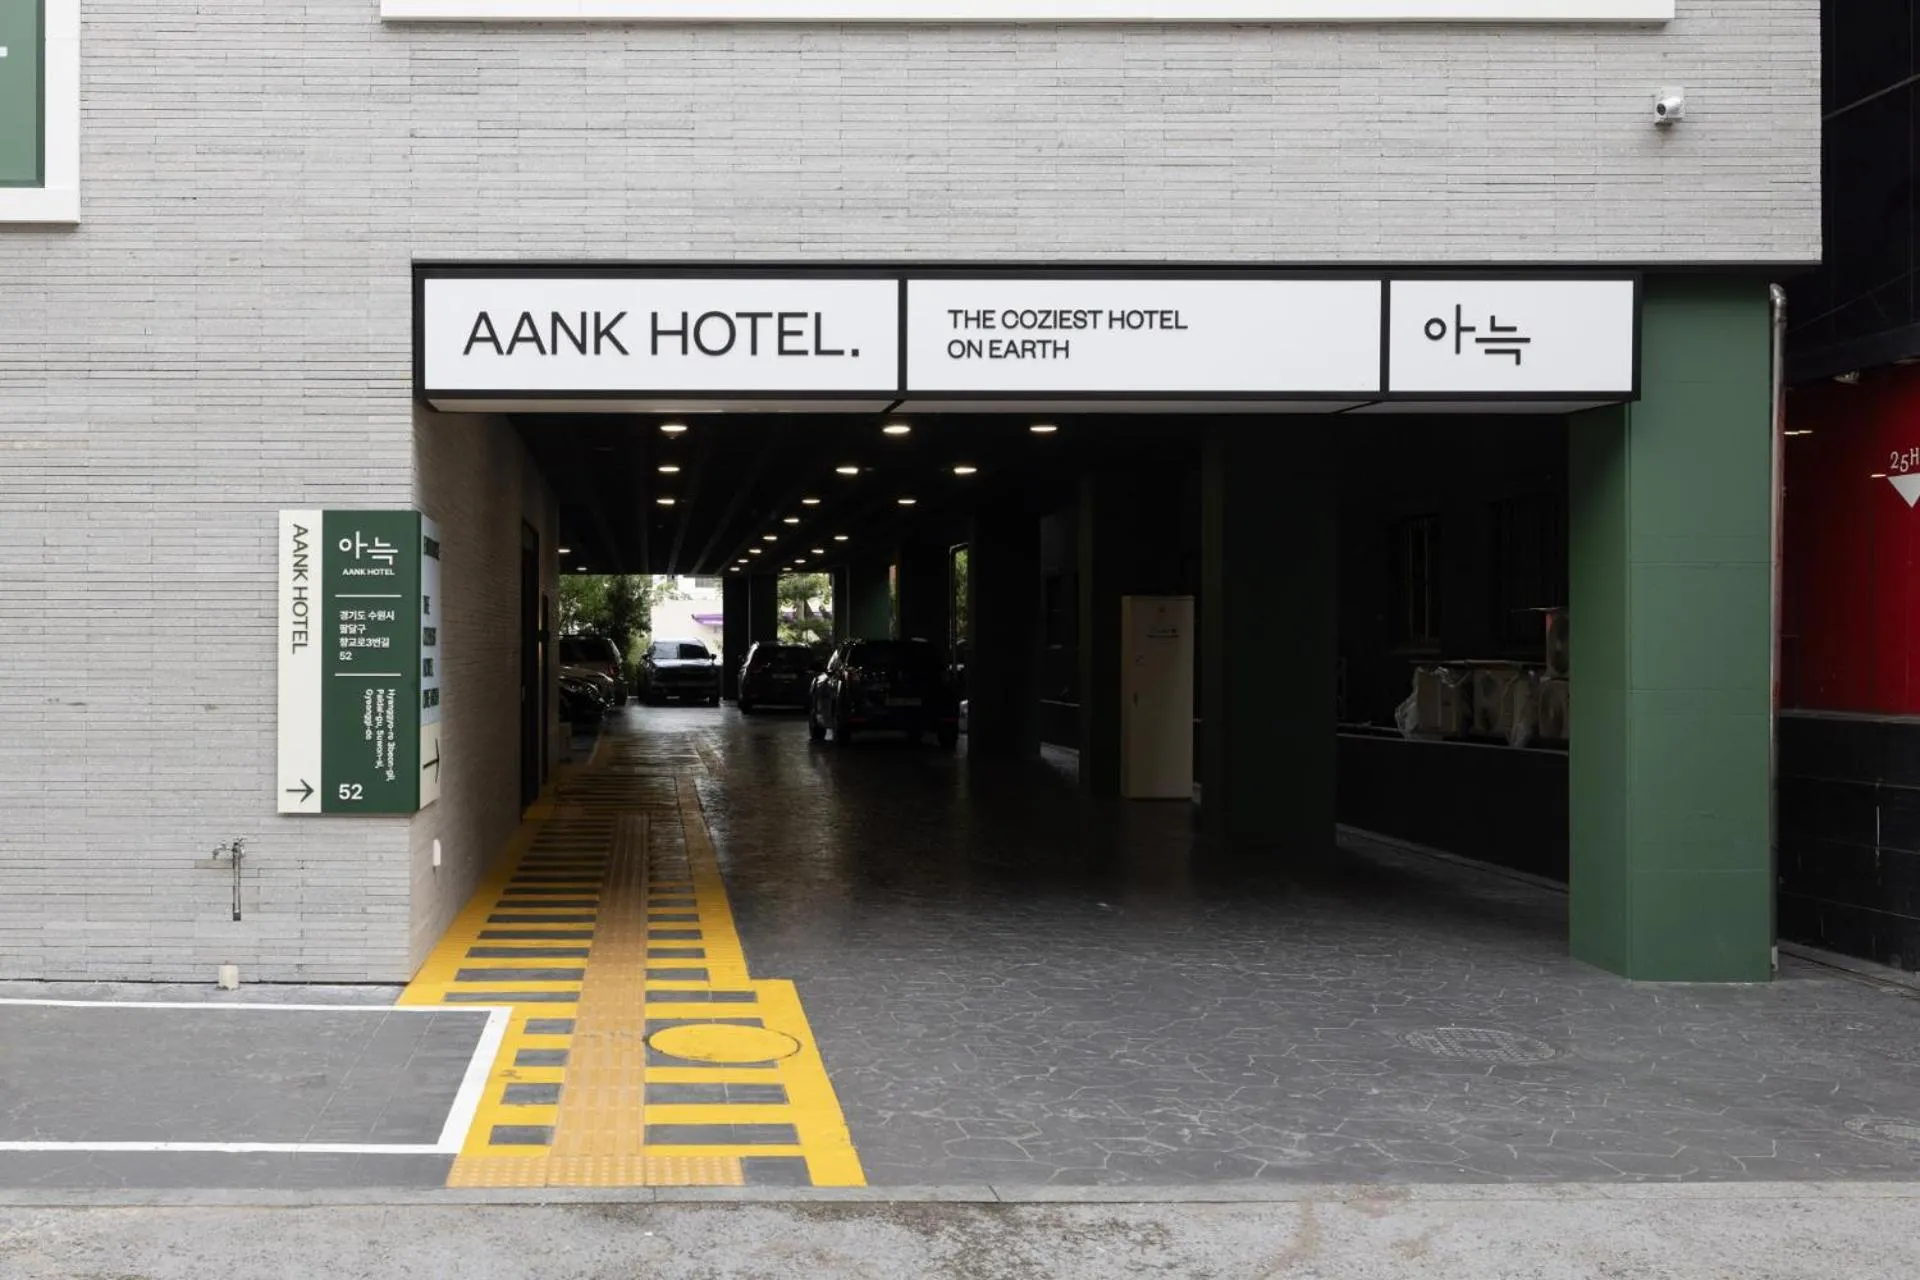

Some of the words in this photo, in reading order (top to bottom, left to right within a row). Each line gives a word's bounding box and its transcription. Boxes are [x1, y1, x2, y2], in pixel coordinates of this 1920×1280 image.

[948, 310, 996, 329] THE
[1001, 310, 1104, 329] COZIEST
[1108, 310, 1189, 329] HOTEL
[463, 311, 629, 356] AANK
[650, 311, 860, 358] HOTEL.
[1423, 303, 1531, 366] 아늑
[947, 339, 983, 359] ON
[988, 340, 1070, 359] EARTH
[292, 523, 309, 582] AANK
[338, 530, 399, 566] 아늑
[342, 568, 366, 576] AANK
[367, 568, 395, 576] HOTEL
[292, 586, 309, 655] HOTEL
[340, 610, 366, 621] 경기도
[367, 610, 395, 621] 수원시
[339, 651, 353, 661] 52
[338, 783, 363, 800] 52
